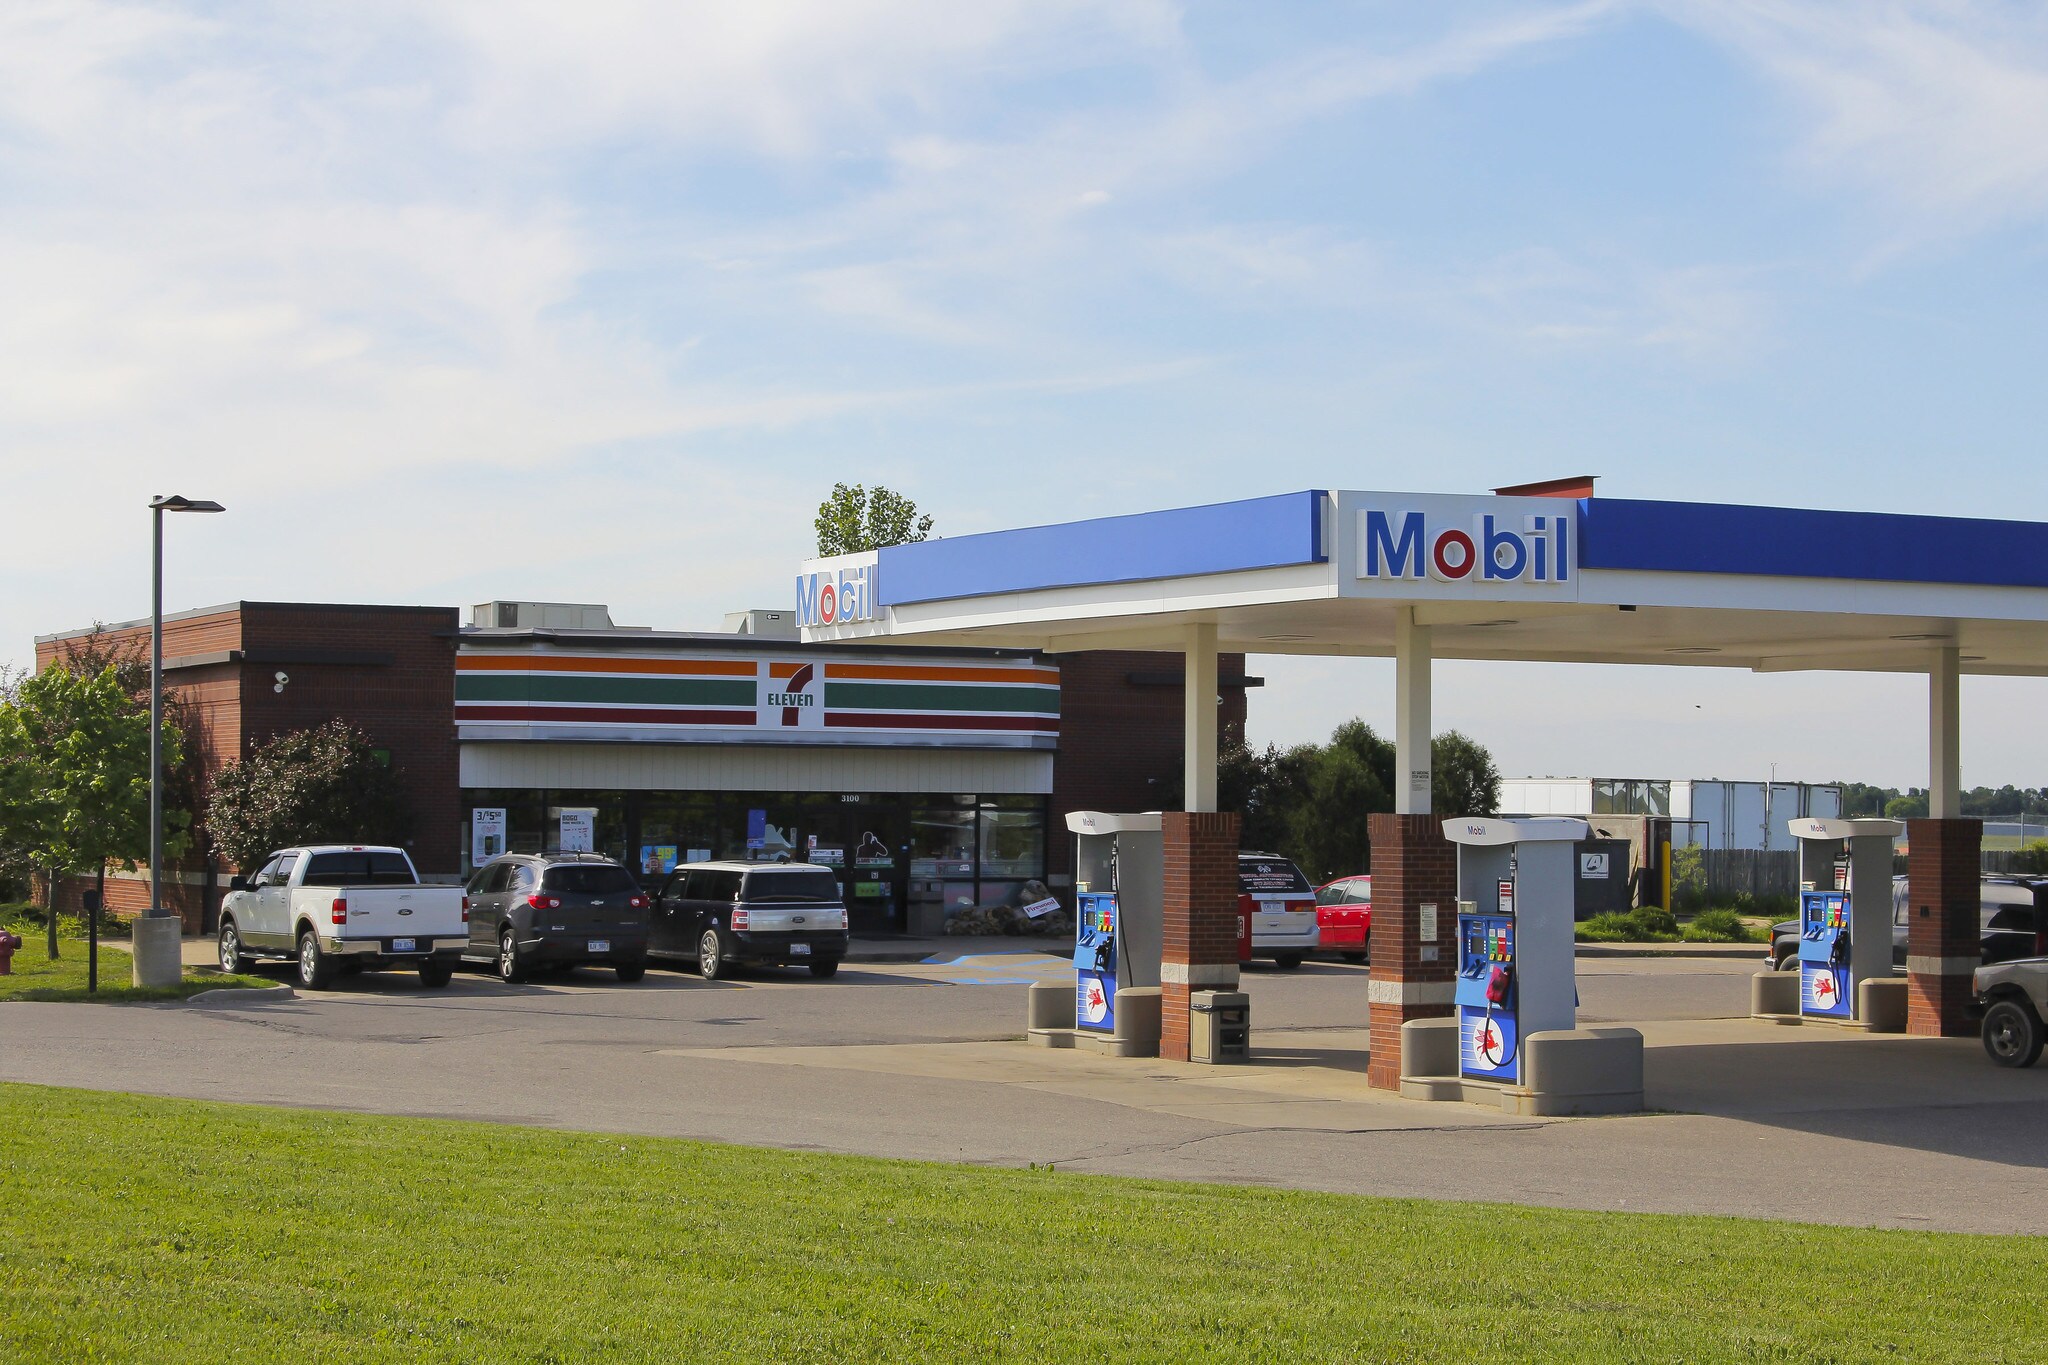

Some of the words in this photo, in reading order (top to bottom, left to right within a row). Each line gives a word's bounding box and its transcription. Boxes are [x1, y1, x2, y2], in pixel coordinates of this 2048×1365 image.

[1363, 509, 1569, 582] Mobil
[795, 564, 873, 628] Mobil
[1082, 817, 1096, 827] Mobil
[1467, 825, 1487, 836] Mobil
[1810, 824, 1827, 833] Mobil
